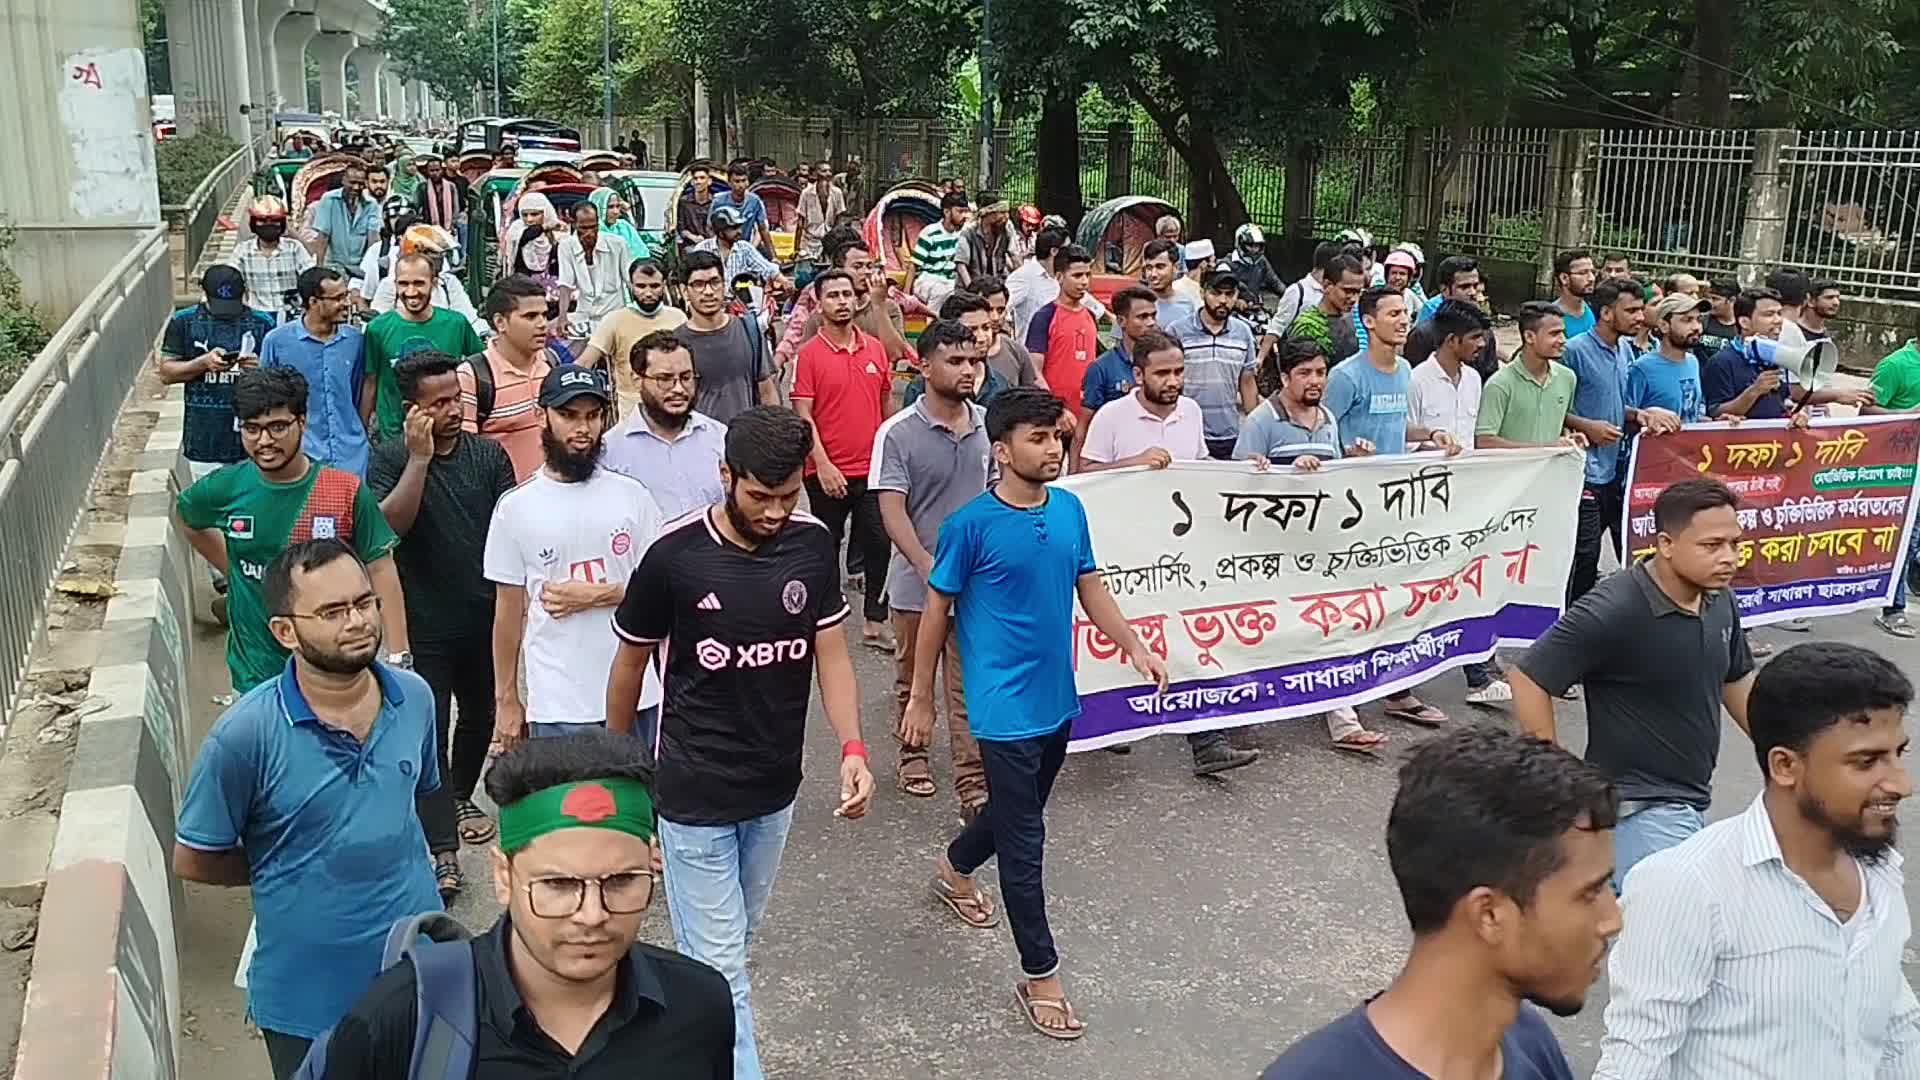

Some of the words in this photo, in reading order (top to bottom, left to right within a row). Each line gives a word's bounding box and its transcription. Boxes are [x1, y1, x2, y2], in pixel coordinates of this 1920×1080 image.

[1697, 444, 1713, 472] ১
[1725, 440, 1783, 469] দফা
[1784, 441, 1803, 468] ১
[1815, 429, 1869, 464] দাবি
[1172, 490, 1193, 537] ১
[1218, 489, 1331, 533] দফা
[1340, 488, 1364, 530] ১
[1378, 464, 1454, 520] দাবি
[1736, 508, 1759, 530] কল্প
[1760, 508, 1773, 527] ও
[1837, 490, 1908, 518] কর্মরতদের
[1098, 551, 1207, 596] টসোর্সিং,
[1216, 551, 1285, 581] প্রকল্প
[1294, 551, 1316, 573] ও
[1323, 532, 1452, 578] চুক্তিভিত্তিক
[1759, 532, 1806, 565] করা
[1807, 527, 1868, 558] চলবে
[1872, 522, 1899, 553] না
[1072, 612, 1170, 673] াজস্ব
[1178, 599, 1278, 671] ভুক্ত
[1287, 582, 1388, 639] করা
[1502, 539, 1541, 586] না
[1768, 583, 1816, 604] সাধারণ
[736, 638, 808, 668] XBTO
[1127, 681, 1259, 715] আয়োজনে
[1280, 659, 1368, 693] সাধারণ
[1371, 628, 1464, 677] শিক্ষার্থীবৃন্দ
